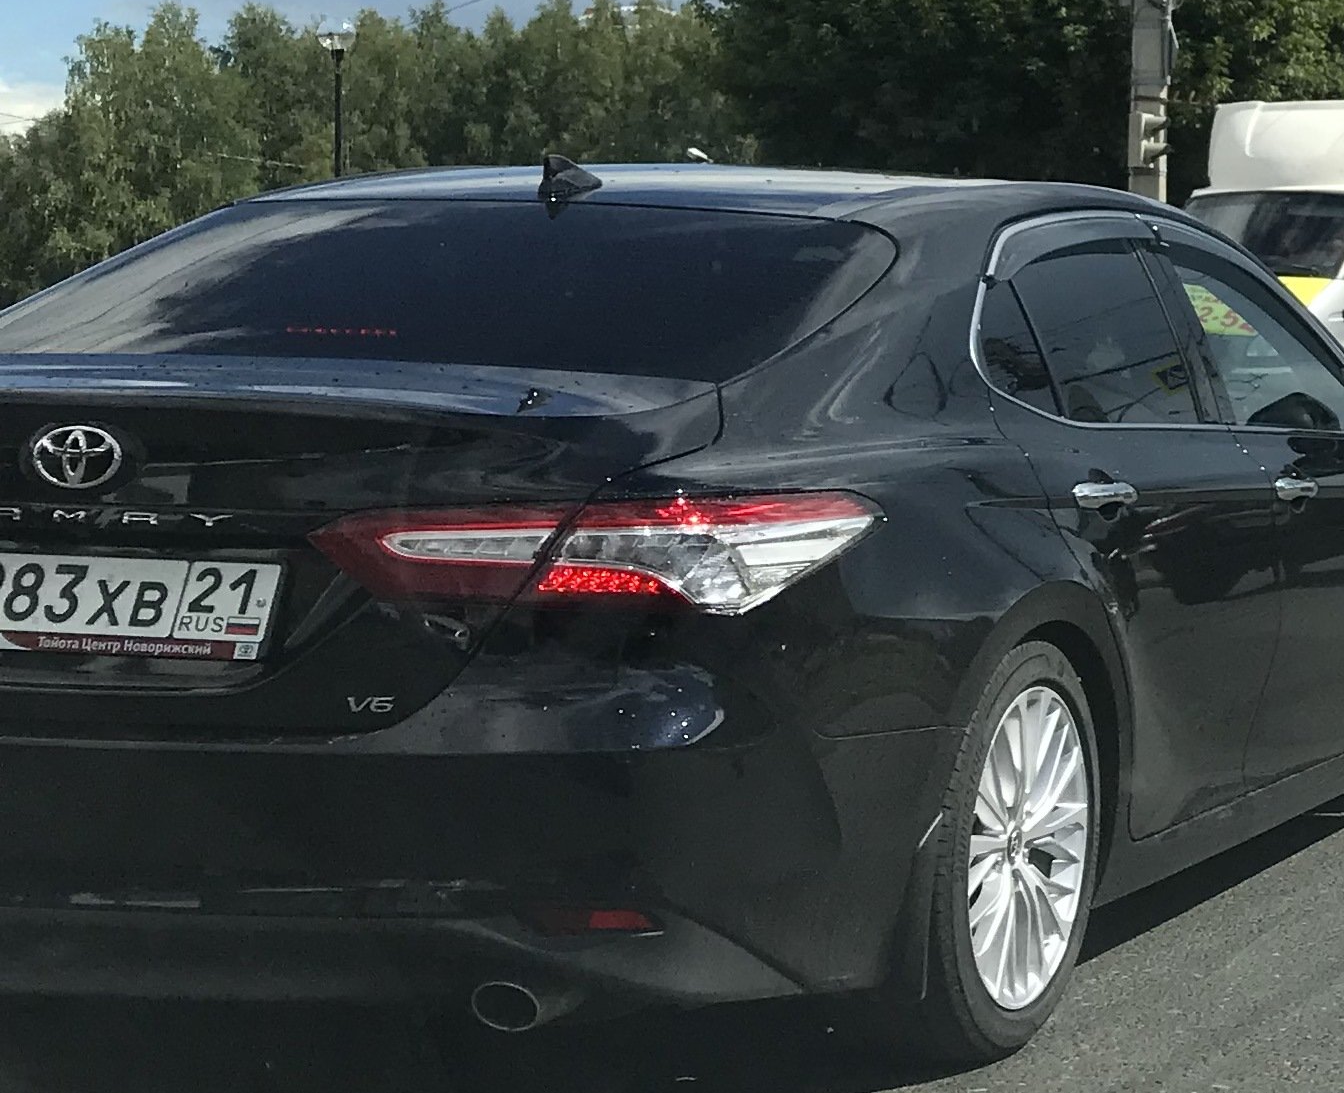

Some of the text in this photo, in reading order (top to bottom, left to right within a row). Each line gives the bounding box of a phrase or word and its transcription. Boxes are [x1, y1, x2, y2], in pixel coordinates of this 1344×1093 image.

[187, 566, 258, 615] 21
[178, 615, 225, 633] RUS
[37, 635, 212, 656] Тойота Центр Новорижский
[346, 696, 395, 713] V6
